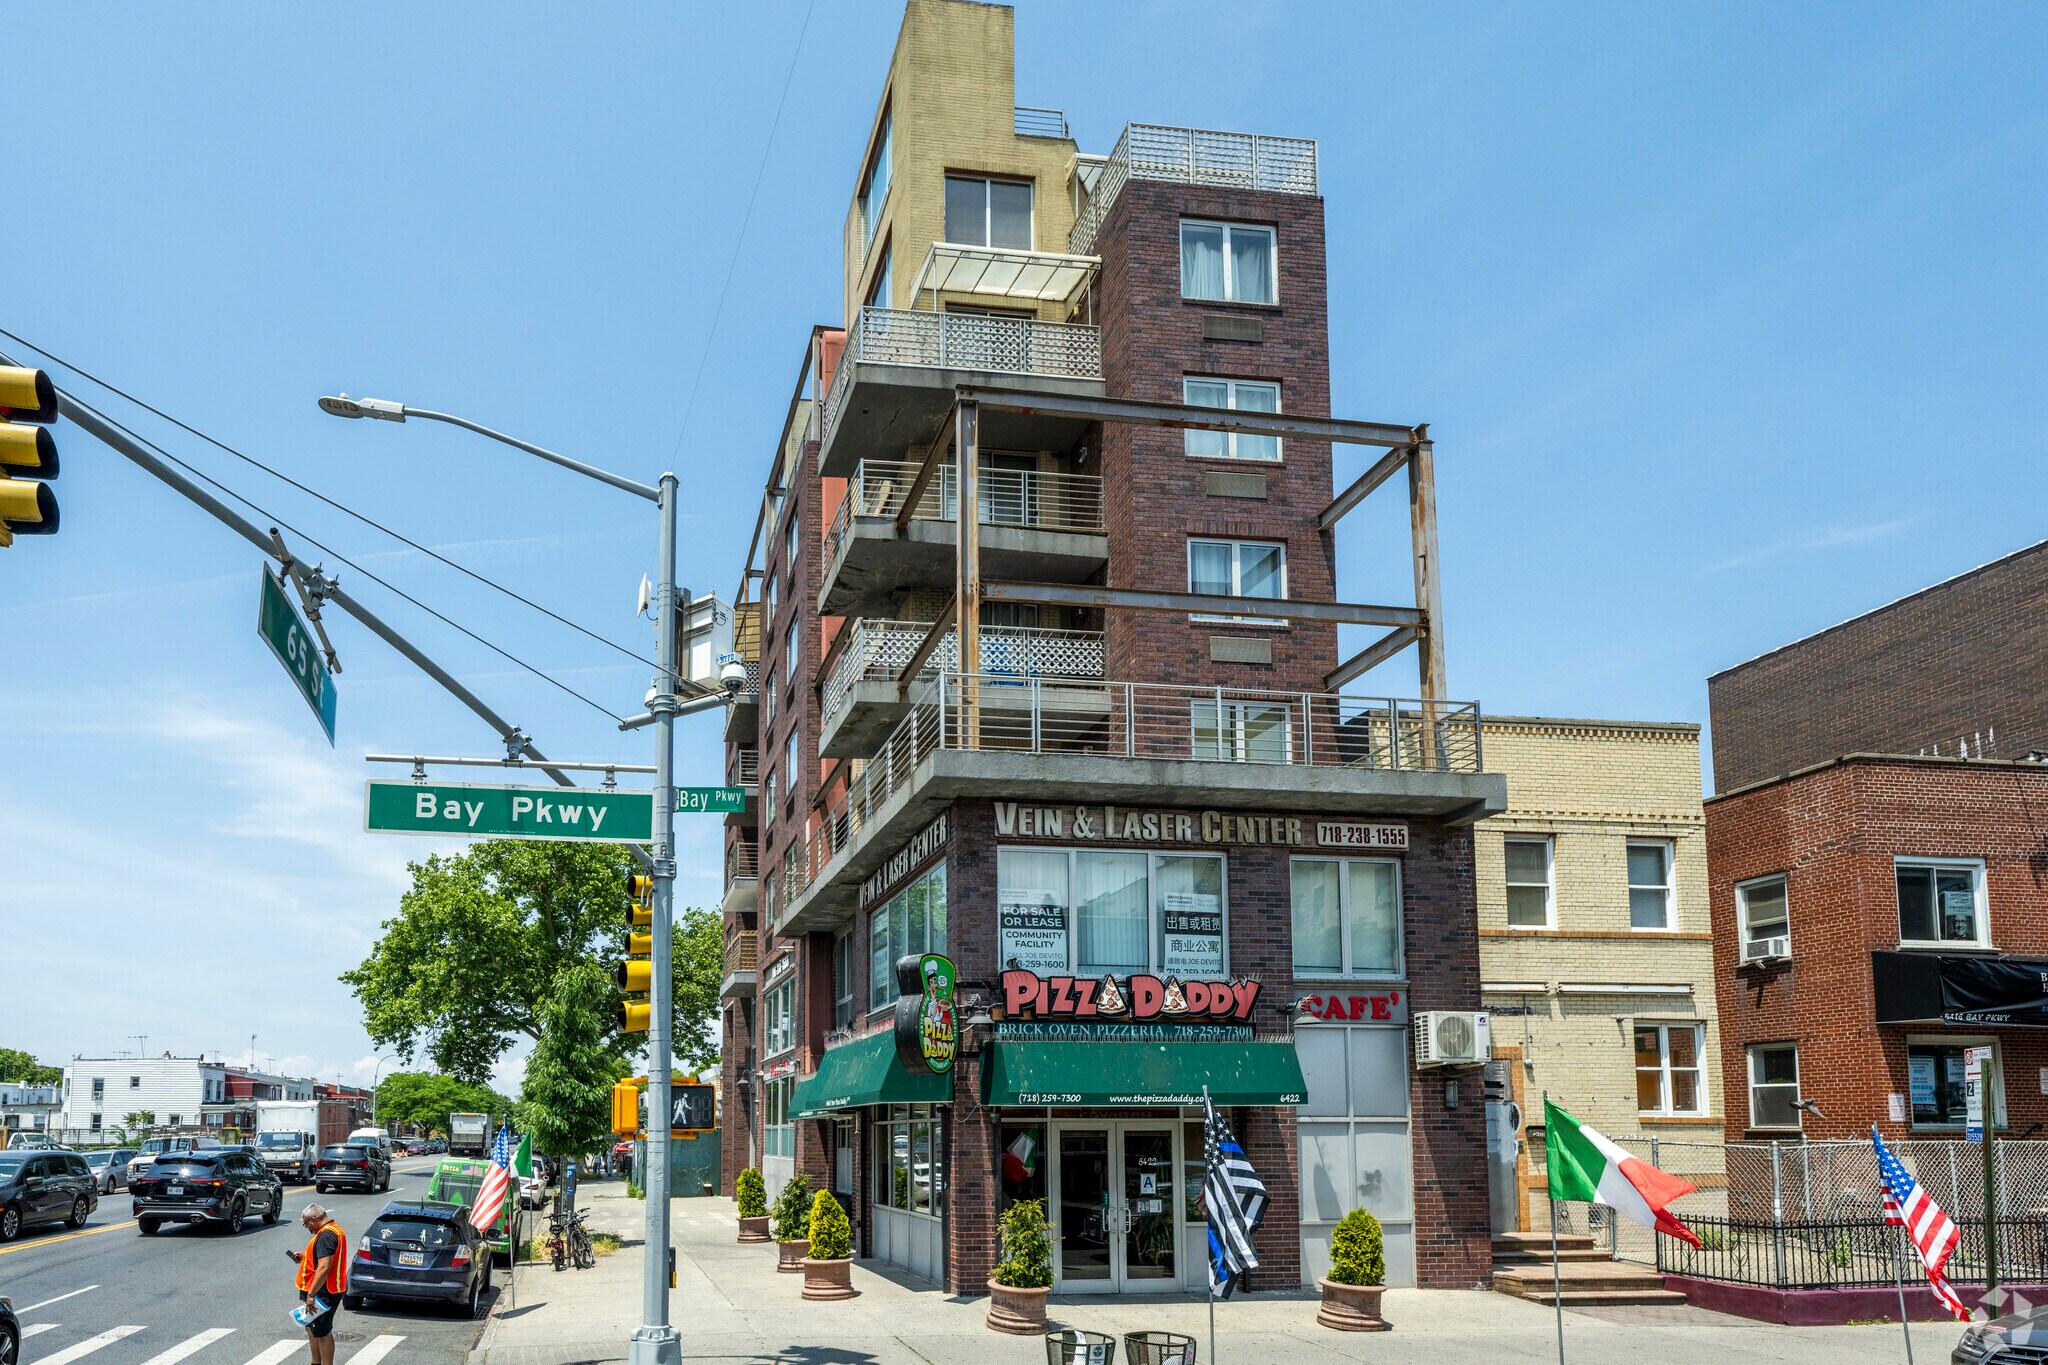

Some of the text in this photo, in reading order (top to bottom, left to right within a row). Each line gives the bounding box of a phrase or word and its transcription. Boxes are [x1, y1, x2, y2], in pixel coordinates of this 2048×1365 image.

[287, 624, 324, 709] 65 St
[680, 790, 741, 812] Bay Pkwy
[416, 793, 608, 831] Bay Pkwy
[994, 802, 1301, 845] VEIN & LASER CENTER
[1321, 826, 1405, 845] 718-238-1555
[884, 849, 909, 890] LASER
[911, 815, 948, 867] CENTER
[1004, 907, 1060, 916] FOR SALE
[1004, 918, 1062, 927] OR LEASE
[1006, 931, 1062, 939] COMMUNITY
[1171, 939, 1219, 953] 商业公寓
[1002, 970, 1263, 1020] PIZZA DADDY
[1986, 1014, 2011, 1022] PKWY
[924, 1017, 954, 1041] PIZZA
[999, 1024, 1252, 1037] BRICK OVEN PIZZERIA 718-259-7300
[924, 1037, 955, 1060] DADDY
[1968, 1083, 1973, 1095] 2
[1019, 1093, 1081, 1104] (718) 259-7300
[1280, 1094, 1300, 1103] 6422
[1138, 1158, 1157, 1166] 6422
[1143, 1176, 1154, 1188] A
